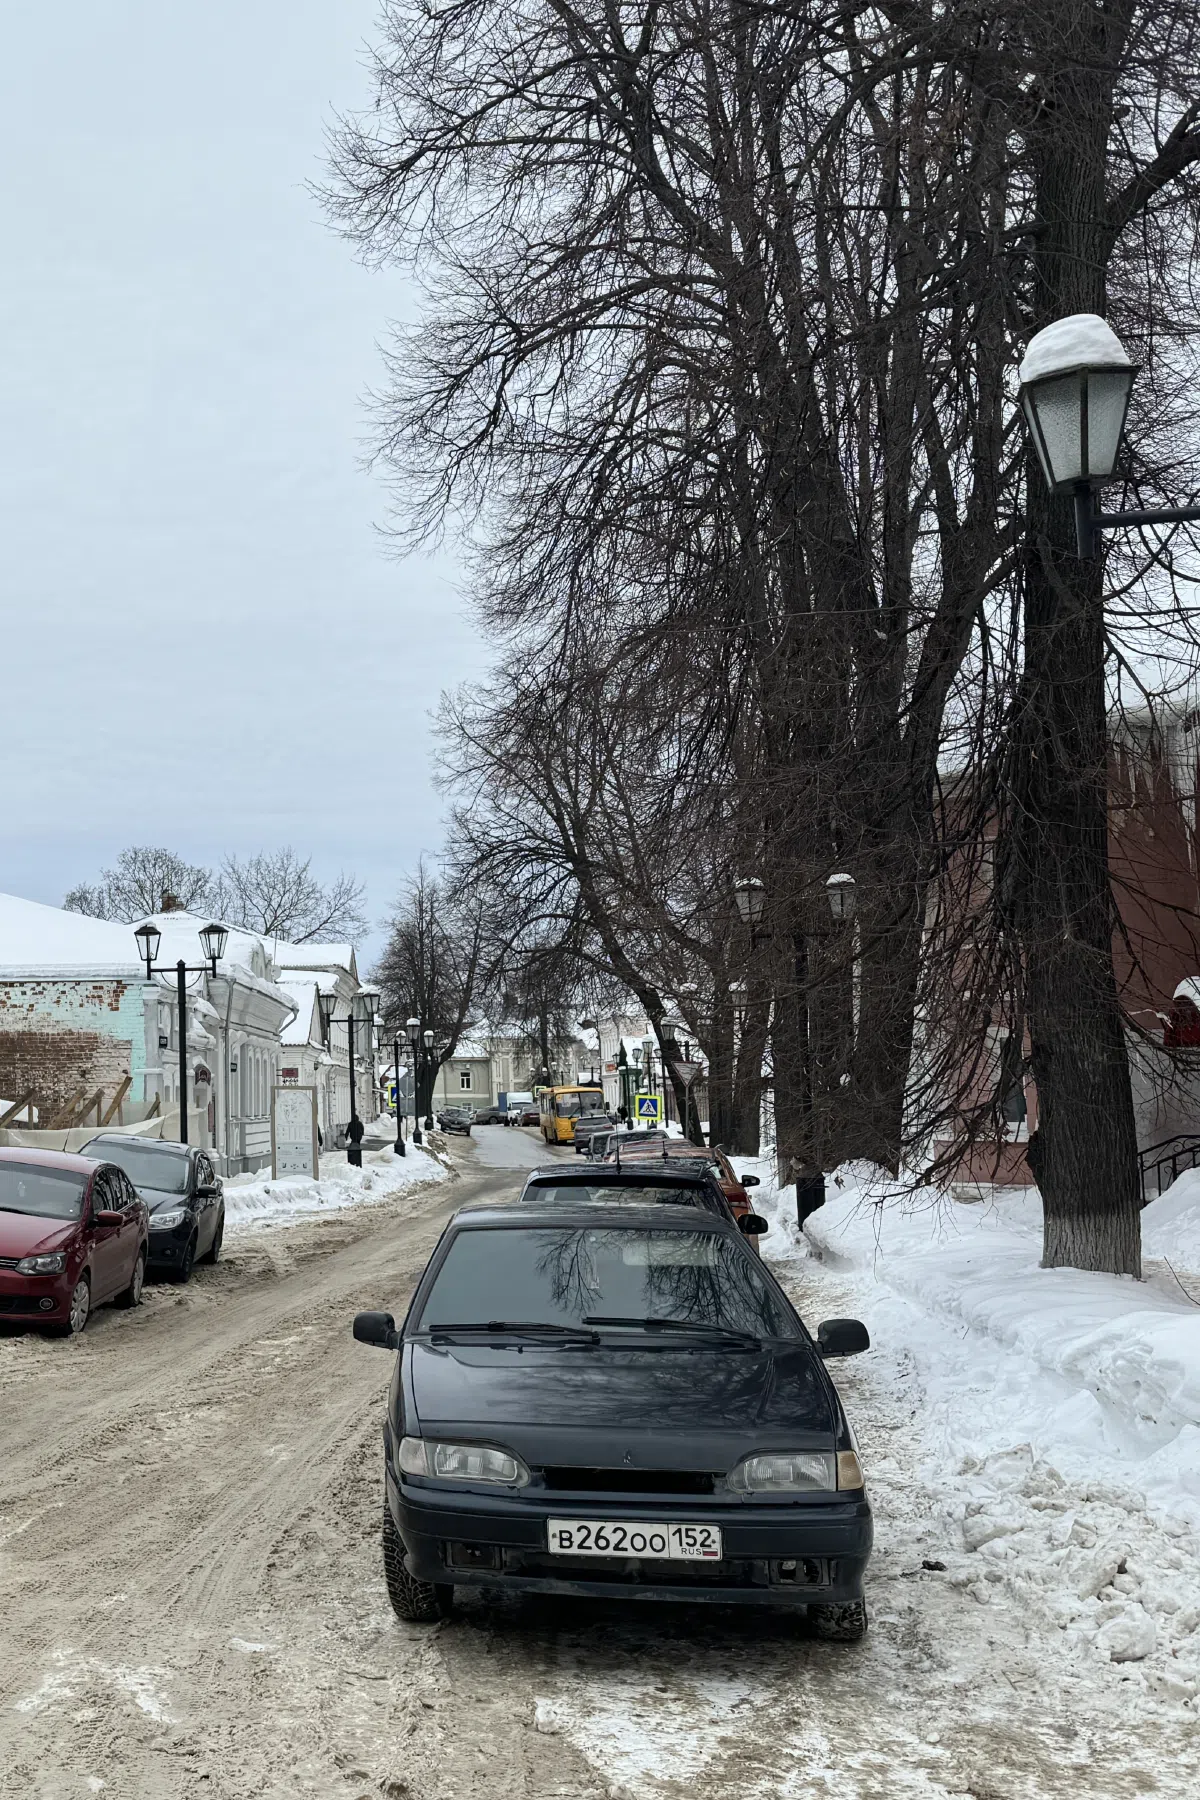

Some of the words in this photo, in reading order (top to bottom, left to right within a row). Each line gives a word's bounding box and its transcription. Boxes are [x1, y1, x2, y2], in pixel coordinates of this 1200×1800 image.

[558, 1525, 666, 1553] В262ОО
[672, 1527, 712, 1548] 152
[681, 1547, 702, 1555] RUS
